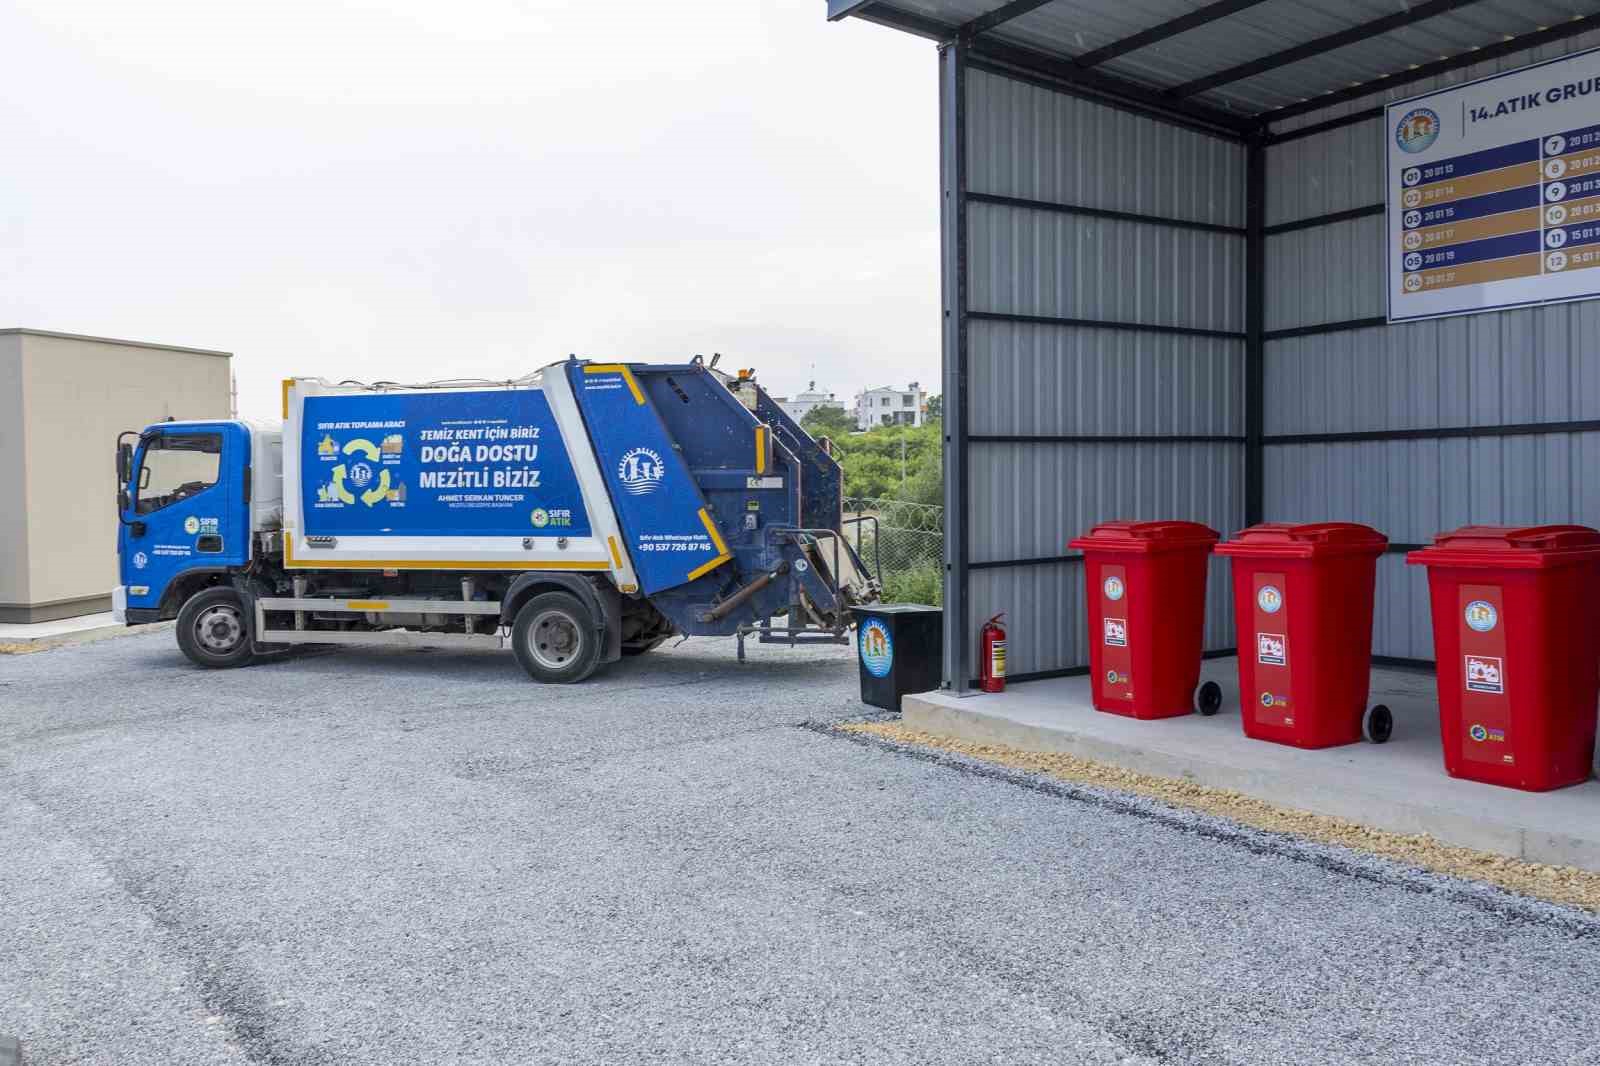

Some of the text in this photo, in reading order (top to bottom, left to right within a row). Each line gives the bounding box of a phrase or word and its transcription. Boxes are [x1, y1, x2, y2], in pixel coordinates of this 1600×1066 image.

[1470, 91, 1541, 123] 14.ATIK
[1569, 136, 1580, 147] 20
[1582, 133, 1592, 144] 01
[1551, 141, 1559, 151] 7
[1407, 171, 1418, 182] 01
[1551, 187, 1560, 197] 9
[1569, 182, 1581, 193] 20
[1583, 180, 1593, 191] 01
[1406, 213, 1419, 225] 03
[1552, 233, 1561, 243] 11
[1572, 230, 1581, 240] 15
[1407, 256, 1420, 267] 05
[455, 428, 485, 440] KENT
[485, 426, 509, 442] İÇİN
[510, 425, 540, 439] BİRİZ
[421, 442, 538, 463] DOĞA DOSTU
[420, 466, 541, 489] MEZİTLİ BİZİZ
[548, 509, 570, 518] SIFIR
[639, 543, 655, 551] +90
[655, 543, 671, 551] 537
[671, 543, 687, 551] 726
